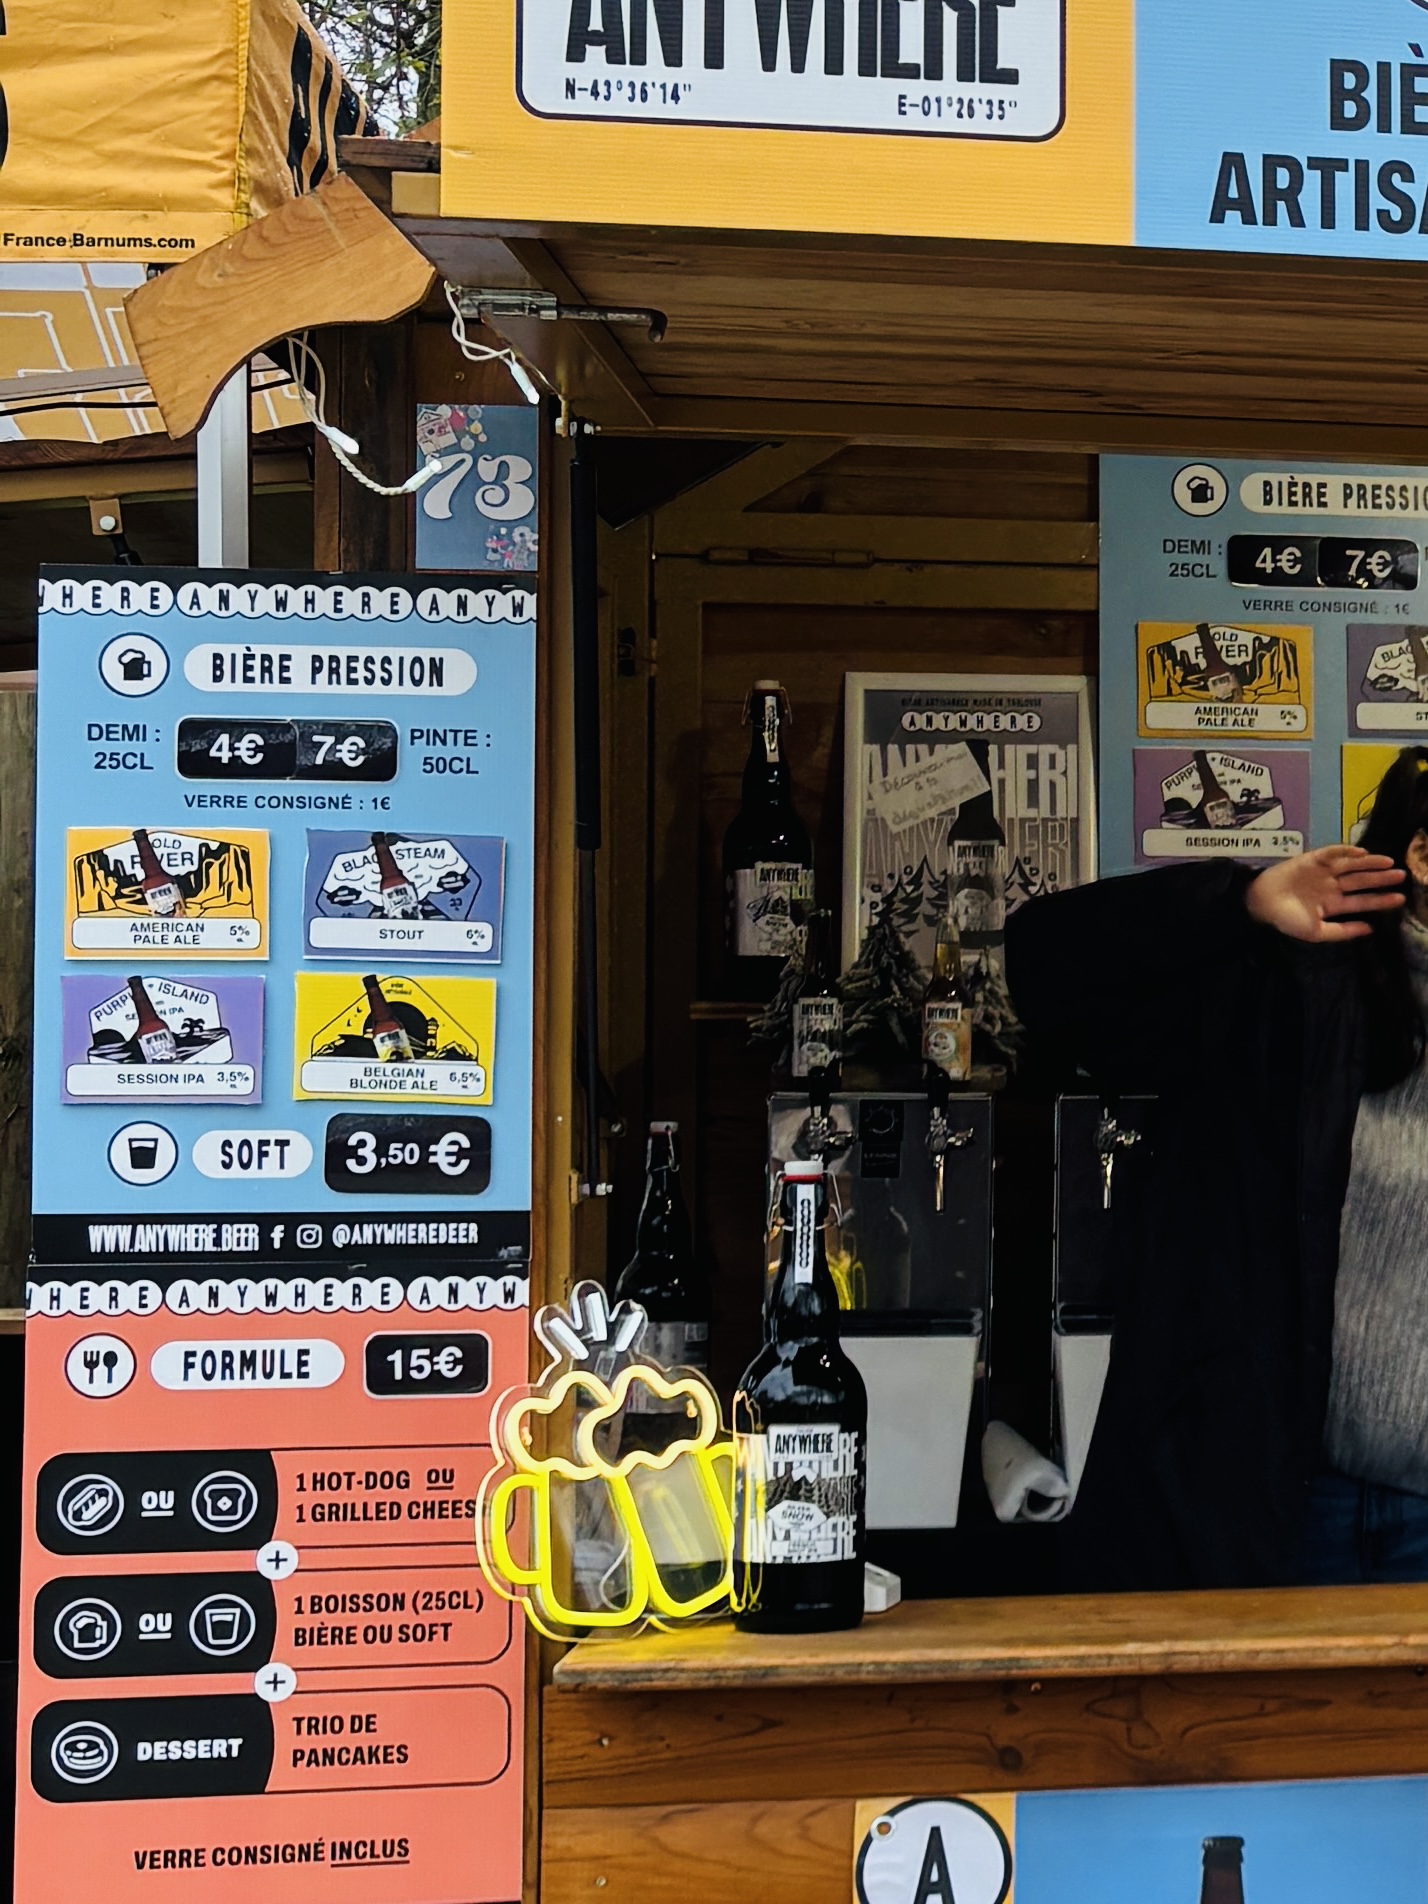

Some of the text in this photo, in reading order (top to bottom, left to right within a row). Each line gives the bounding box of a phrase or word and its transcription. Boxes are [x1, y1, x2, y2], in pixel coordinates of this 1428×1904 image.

[1262, 475, 1328, 509] BIÈRE
[1162, 538, 1212, 556] DEMI
[1169, 562, 1218, 579] 25CL
[1255, 547, 1302, 575] 4€
[1345, 549, 1392, 579] 7€
[188, 583, 401, 615] ANYWHERE
[1242, 599, 1379, 614] VERRE CONSIGNÉ
[212, 646, 444, 688] BIÈRE PRESSION
[908, 715, 1035, 728] ANYWHERE
[1194, 706, 1259, 718] AMERICAN
[87, 723, 149, 741] DEMI
[410, 728, 479, 747] PINTE
[209, 733, 265, 765] 4€
[311, 734, 366, 767] 7€
[94, 752, 154, 771] 25CL
[422, 756, 480, 775] 50CL
[184, 792, 352, 810] VERRE CONSIGNÉ
[395, 847, 445, 860] STEAM
[130, 922, 204, 932] AMERICAN
[379, 929, 424, 940] STOUT
[134, 934, 200, 944] PALE ALE
[158, 982, 209, 1005] ISLAND
[118, 1074, 205, 1084] SESSION IPA
[364, 1067, 425, 1079] BELGIAN
[350, 1078, 438, 1091] BLONDE ALE
[220, 1138, 291, 1170] SOFT
[89, 1223, 479, 1253] WWW.ANYWHERE.BEER @ANYWHEREBEER
[180, 1283, 391, 1309] ANYWHERE
[183, 1349, 311, 1382] FORMULE
[387, 1346, 464, 1380] 15€
[775, 1433, 834, 1454] ANYWHERE
[311, 1471, 411, 1491] HOT-DOG
[311, 1503, 402, 1523] GRILLED
[310, 1590, 484, 1614] BOISSON (25CL)
[293, 1620, 453, 1647] BIÈRE OU SOFT
[292, 1714, 377, 1736] TRIO DE
[136, 1738, 243, 1761] DESSERT
[292, 1744, 409, 1769] PANCAKES
[134, 1837, 410, 1871] VERRE CONSIGNÉ INCLUS
